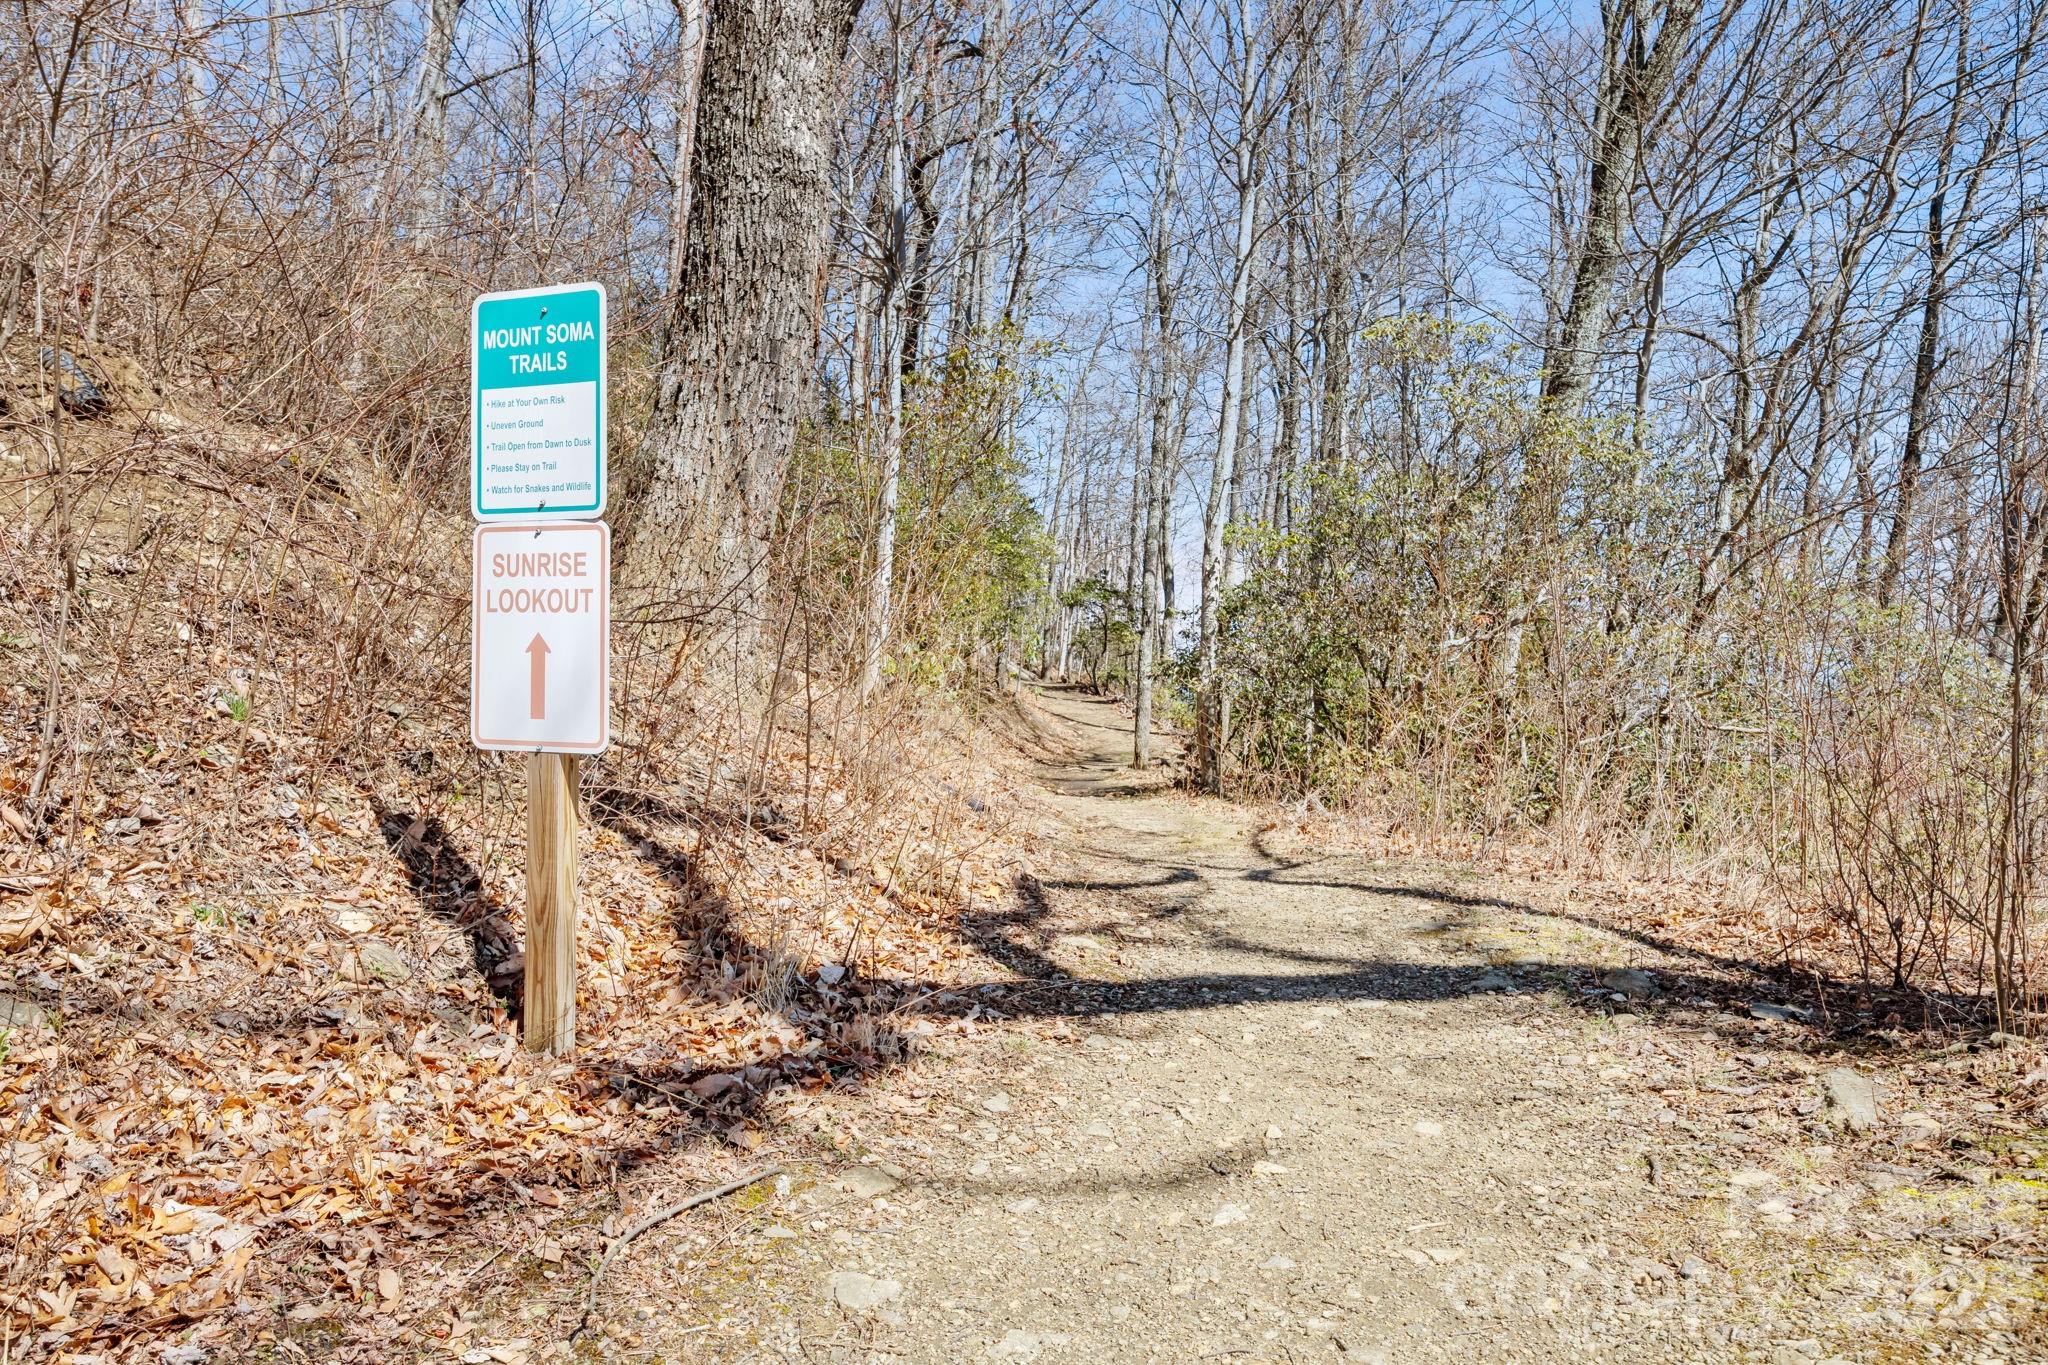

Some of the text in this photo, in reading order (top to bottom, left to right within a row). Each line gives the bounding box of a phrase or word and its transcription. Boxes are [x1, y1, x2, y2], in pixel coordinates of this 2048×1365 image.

[483, 321, 595, 350] MOUNT SOMA
[508, 351, 568, 374] TRAILS
[491, 395, 566, 409] Hike at Your Own Risk
[491, 419, 544, 430] Uneven Ground
[491, 437, 592, 452] Trail Open from Dawn to Dusk
[491, 464, 514, 473] Please
[515, 463, 530, 473] Stay
[542, 461, 557, 471] Trail
[491, 481, 592, 495] Watch for Snakes and Wildlife
[492, 552, 587, 577] SUNRISE
[486, 588, 594, 613] LOOKOUT
